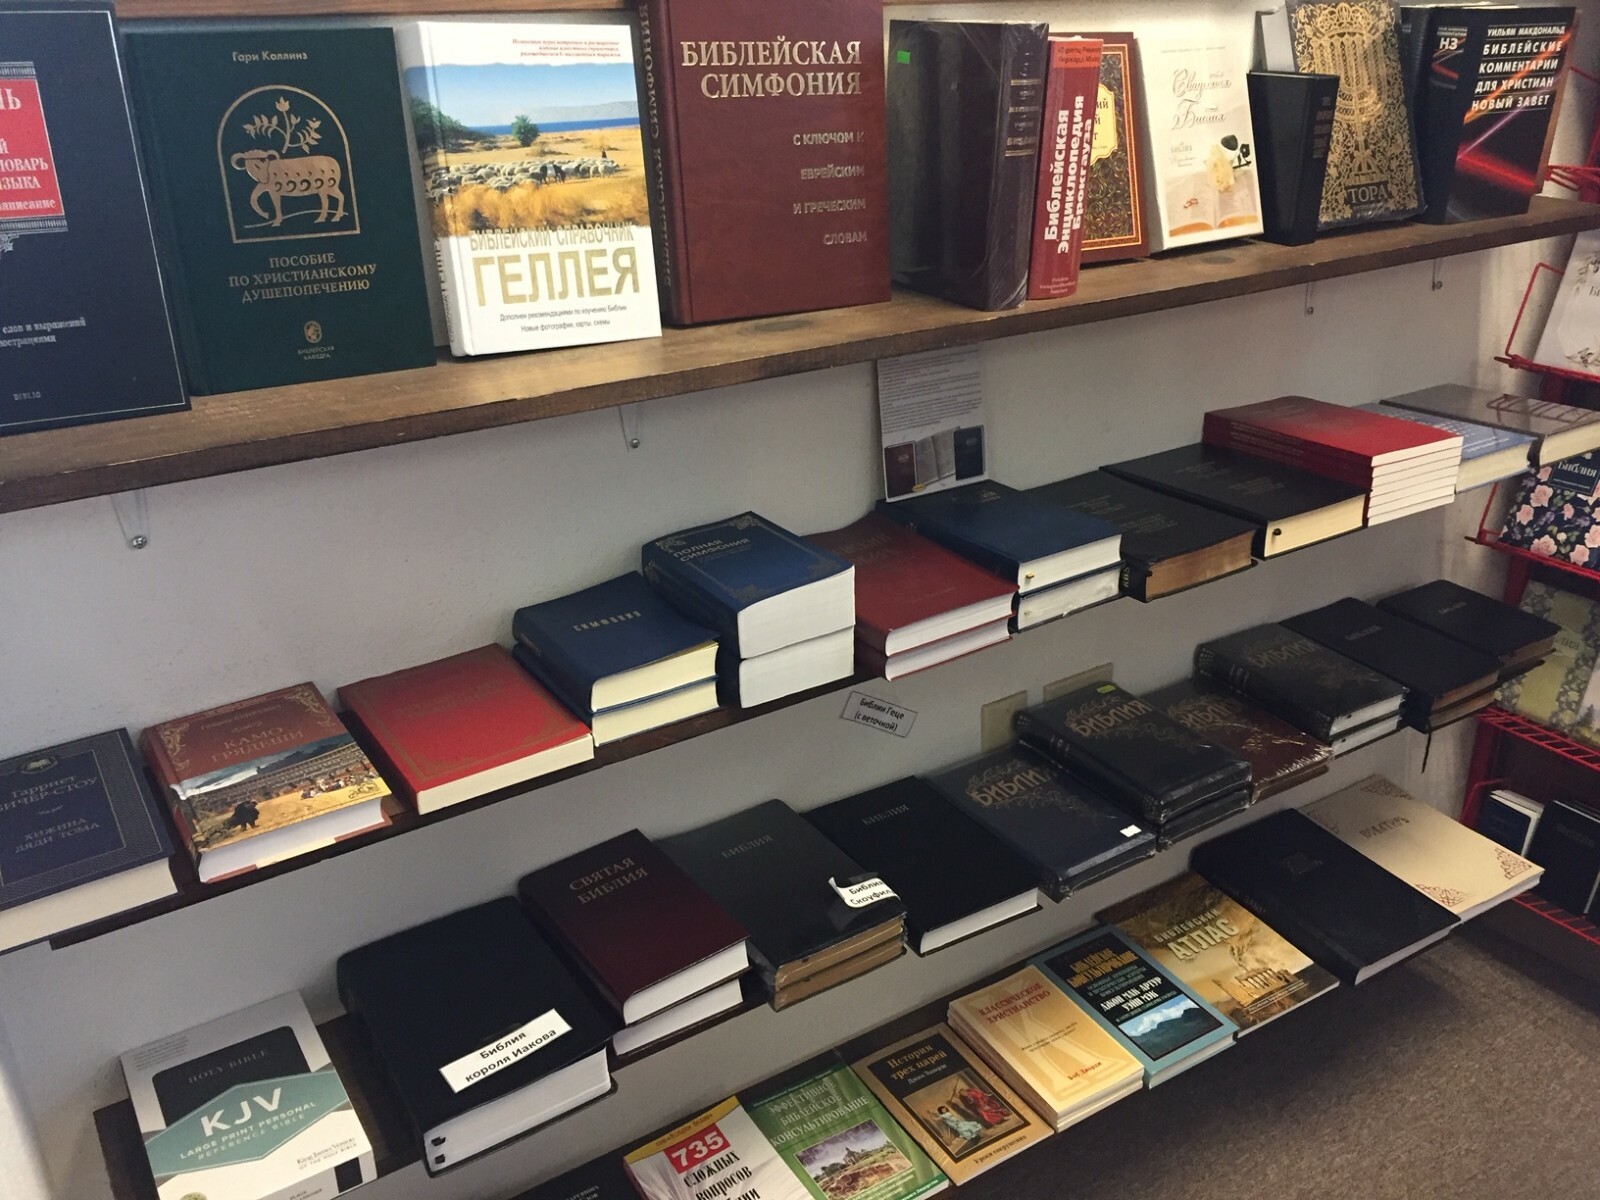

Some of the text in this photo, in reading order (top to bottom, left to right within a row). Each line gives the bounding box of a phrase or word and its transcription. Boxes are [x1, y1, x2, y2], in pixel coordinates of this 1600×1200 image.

[1487, 26, 1566, 37] УИЛЬЯМ МАКДОНАЛЬД
[232, 51, 308, 64] Гари Коллинз
[680, 35, 862, 67] БИБЛЕЙСКАЯ
[1483, 40, 1563, 56] БИБЛЕЙСКИЕ
[1479, 59, 1558, 74] КОММЕНТАРИИ
[700, 72, 862, 99] СИМФОНИЯ
[1475, 76, 1554, 94] ДЛЯ ХРИСТИАН
[1472, 95, 1550, 111] НОВЫЙ ЗАВЕТ
[793, 134, 801, 146] С
[803, 131, 854, 145] КЛЮЧОМ
[0, 176, 41, 190] ЗЫКА
[800, 163, 865, 180] ЕВРЕЙСКИМ
[1044, 109, 1070, 240] Библейская
[1057, 95, 1085, 253] Энциклопедия
[1073, 118, 1092, 230] Брокгауза
[0, 199, 56, 211] аписание
[1348, 184, 1388, 203] ТОРА
[793, 198, 866, 215] И ГРЕЧЕСКИМ
[470, 221, 634, 251] БИБЛЕЙСКИЙ СПРАВОЧНИК
[823, 231, 868, 245] СЛОВАМ
[269, 253, 336, 269] ПОСОБИЕ
[228, 263, 377, 288] ПО ХРИСТИАНСКОМУ
[472, 246, 640, 307] ГЕЛЛЕЯ
[241, 279, 371, 304] ДУШЕПОПЕЧЕНИЮ
[1557, 460, 1597, 477] Библия
[673, 539, 723, 558] ПОЛНАЯ
[680, 538, 751, 562] СИМФОНИЯ
[861, 716, 898, 732] веточкой)
[886, 706, 905, 720] Геце
[1070, 697, 1154, 738] БИБЛИЯ
[223, 727, 284, 749] КАМО
[862, 803, 911, 826] БИБЛИЯ
[59, 822, 100, 839] ТОМА
[720, 834, 774, 859] БИБЛИЯ
[569, 857, 635, 890] СВЯТАЯ
[577, 867, 648, 904] БИБЛИЯ
[850, 889, 893, 905] Скоуфил
[1154, 908, 1221, 943] БИБЛЕЙСКИЙ
[1167, 918, 1240, 961] АТЛАС
[978, 982, 1044, 1016] КЛАССИЧЕСКОЕ
[985, 990, 1051, 1024] ХРИСТИАНСТВО
[465, 1029, 557, 1082] короля Иакова
[480, 1032, 527, 1059] Библия
[887, 1045, 934, 1069] История
[890, 1050, 948, 1080] трех царей
[769, 1078, 837, 1114] ЭФФЕКТИВНОЕ
[200, 1087, 281, 1137] KJV
[769, 1095, 870, 1147] КОНСУЛЬТИРОВАНИЕ
[780, 1092, 842, 1126] БИБЛЕЙСКОЕ
[180, 1102, 316, 1160] LARGE PRINT PERSONAL
[197, 1113, 305, 1160] REFERENCE BIBLE
[671, 1131, 724, 1167] 735
